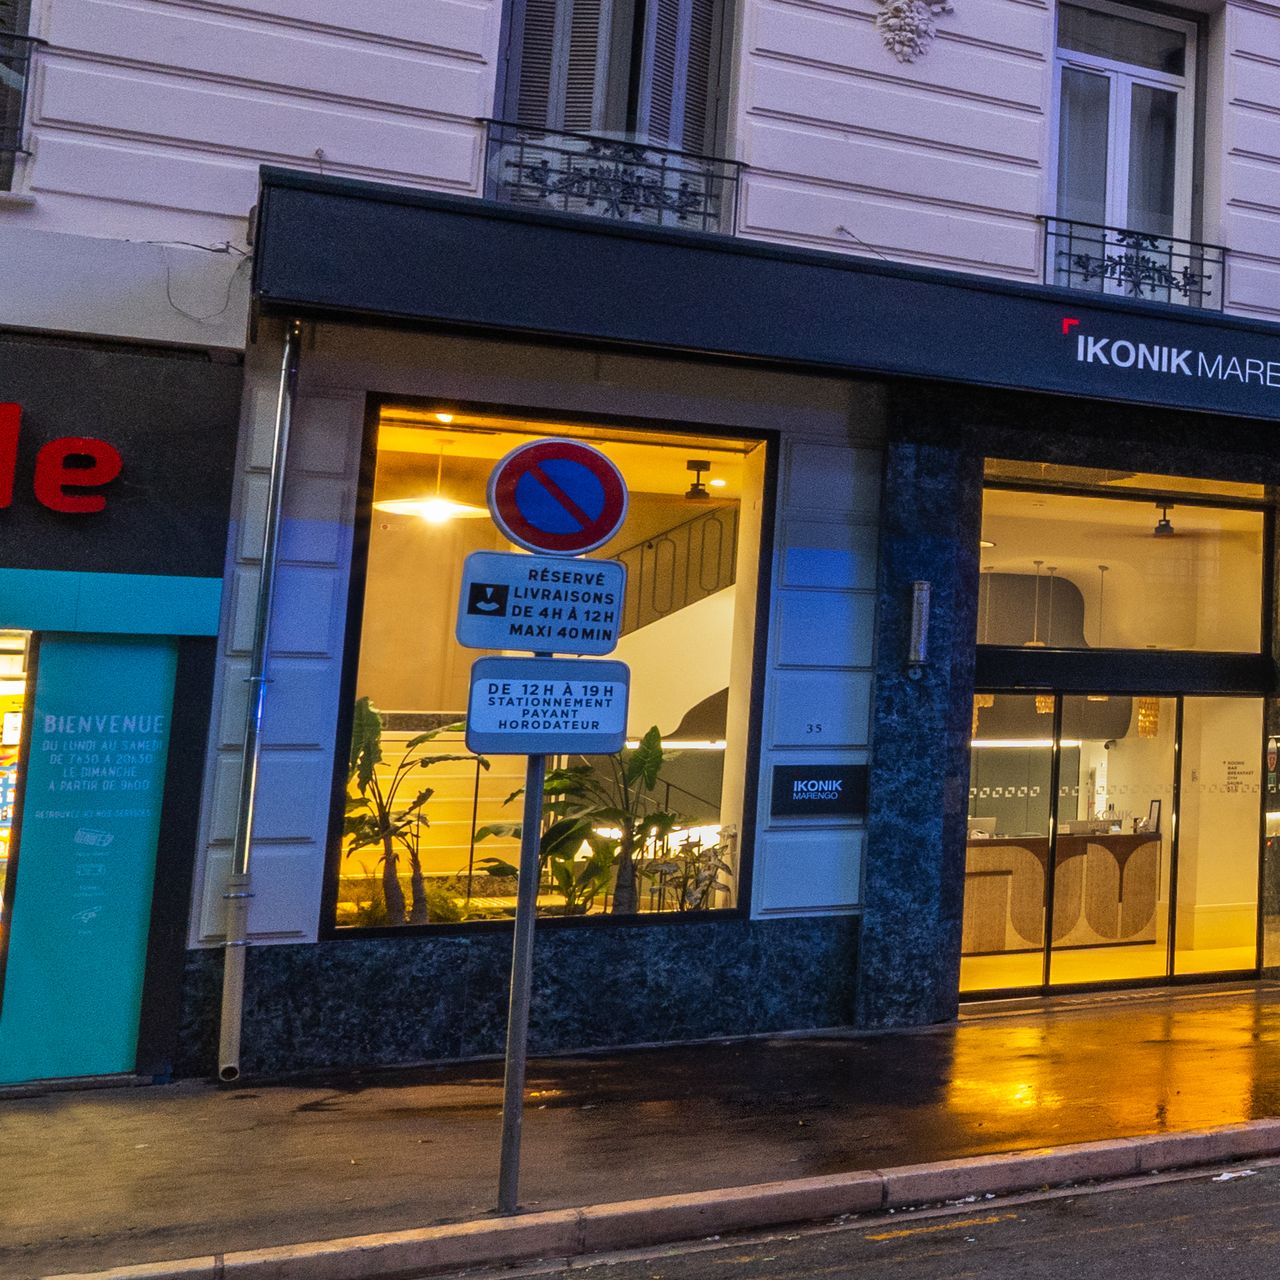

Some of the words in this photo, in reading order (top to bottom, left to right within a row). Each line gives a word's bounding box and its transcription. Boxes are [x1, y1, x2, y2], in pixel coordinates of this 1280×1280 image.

[1077, 334, 1193, 376] IKONIK
[528, 568, 606, 586] RÉSERVÉ
[514, 587, 615, 605] LIVRAISONS
[511, 605, 534, 618] DE
[539, 607, 563, 620] 4H
[567, 607, 578, 621] À
[584, 609, 615, 623] 12H
[509, 623, 553, 638] MAXI
[488, 683, 511, 695] DE
[563, 682, 573, 696] À
[488, 696, 613, 708] STATIONNEMENT
[522, 709, 579, 719] PAYANT
[44, 714, 165, 734] BIENVENUE
[498, 720, 600, 730] HORODATEUR
[806, 723, 823, 734] 35
[42, 740, 58, 751] DU
[63, 740, 97, 751] LUNDI
[101, 740, 117, 751] AU
[121, 740, 163, 752] SAMEDI
[49, 754, 63, 764] DE
[63, 766, 77, 778] LE
[81, 766, 137, 777] DIMANCHE
[60, 780, 98, 791] PARTIR
[102, 780, 117, 791] DE
[793, 780, 843, 792] IKONIK
[792, 791, 839, 800] MARENGO
